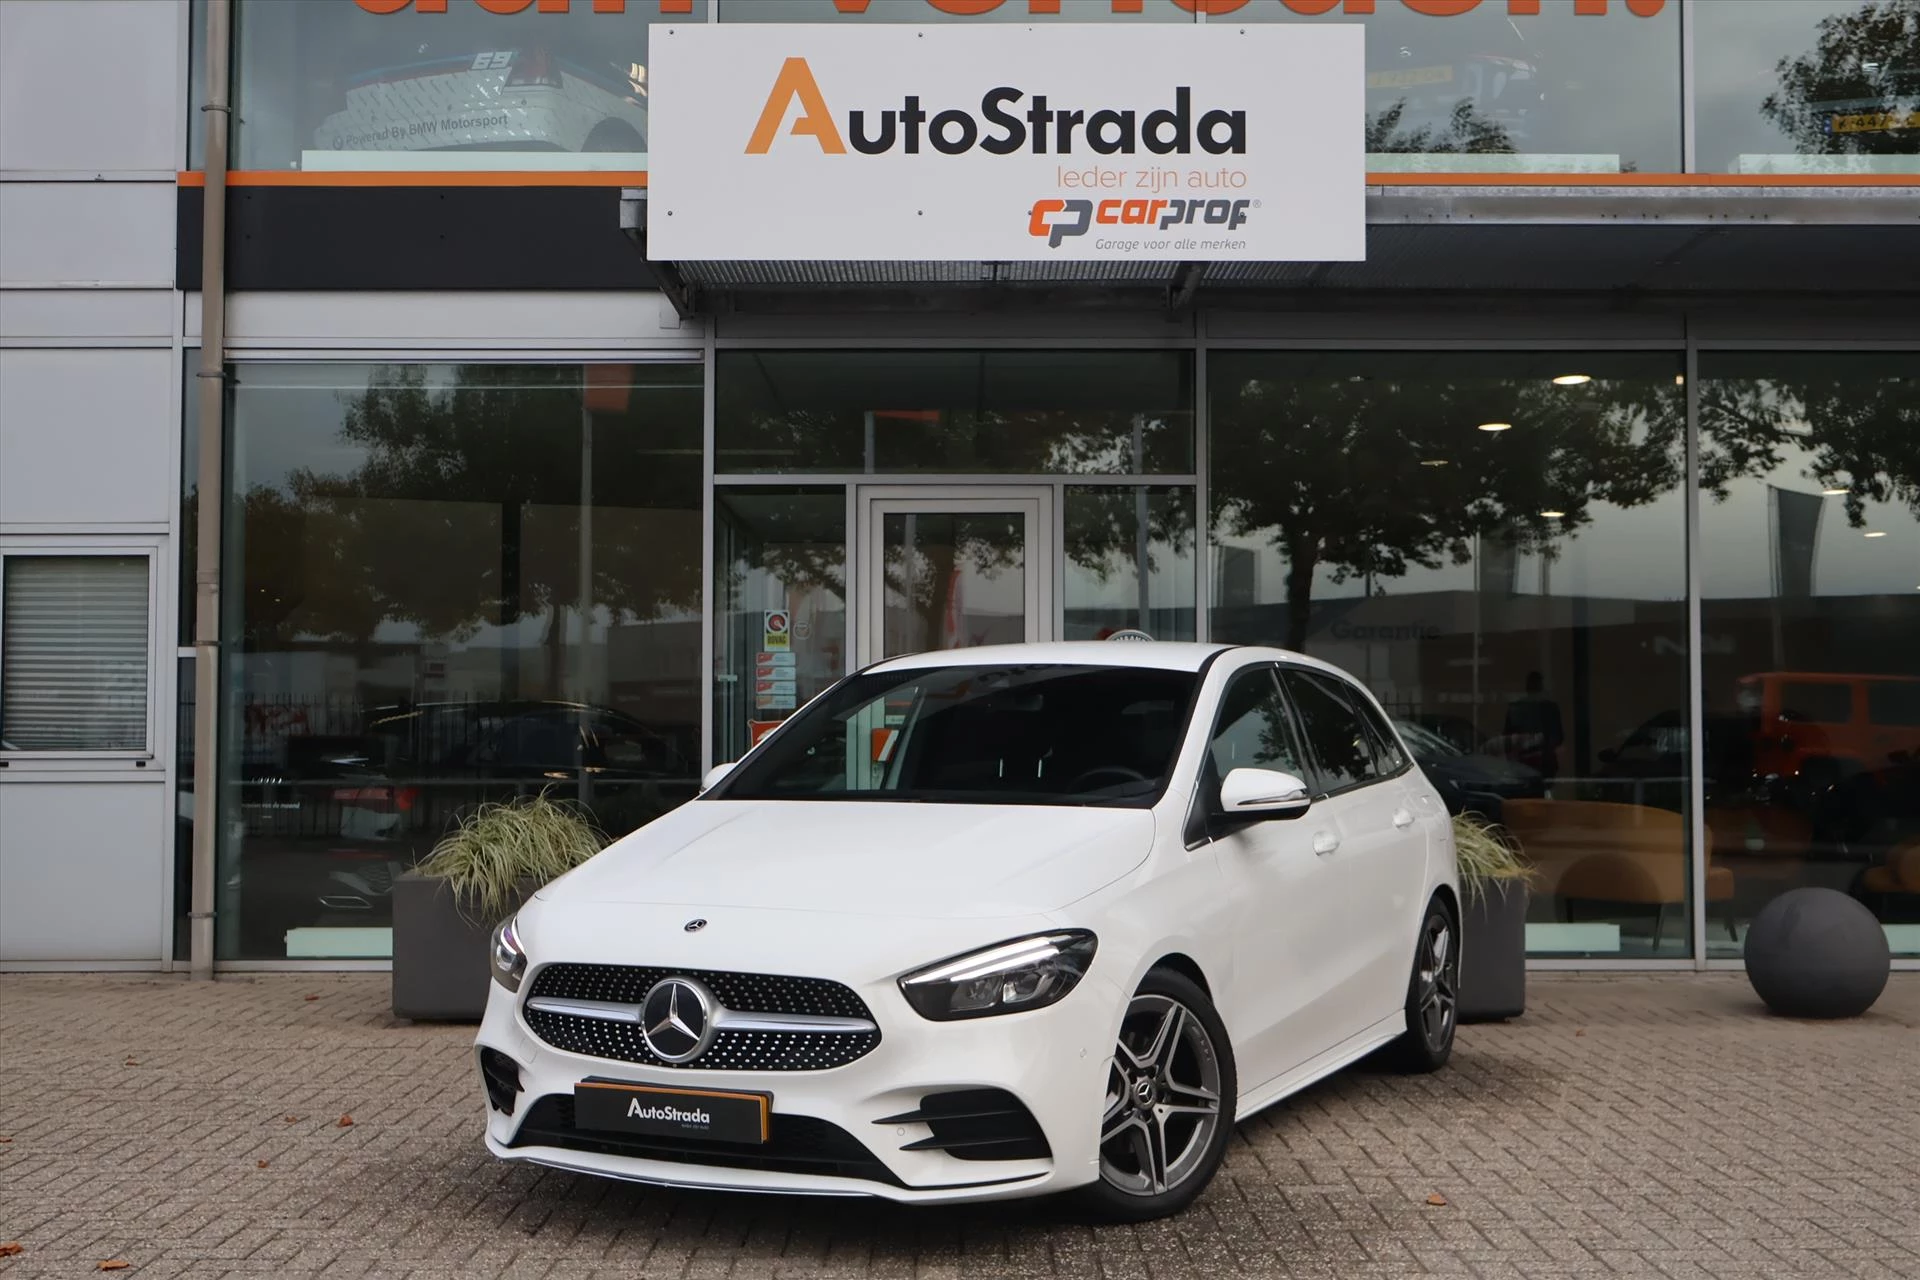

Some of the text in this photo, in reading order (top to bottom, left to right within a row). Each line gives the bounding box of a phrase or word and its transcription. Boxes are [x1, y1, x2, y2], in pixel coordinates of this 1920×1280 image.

[471, 52, 513, 70] 69
[744, 57, 1246, 155] AutoStrada
[346, 114, 508, 144] Powered By BMW Motorsport
[1057, 166, 1247, 193] Ieder zijn auto
[1095, 239, 1246, 252] Garage voor alle merken
[1330, 620, 1440, 640] Garantie
[627, 1098, 710, 1124] AutoStrada
